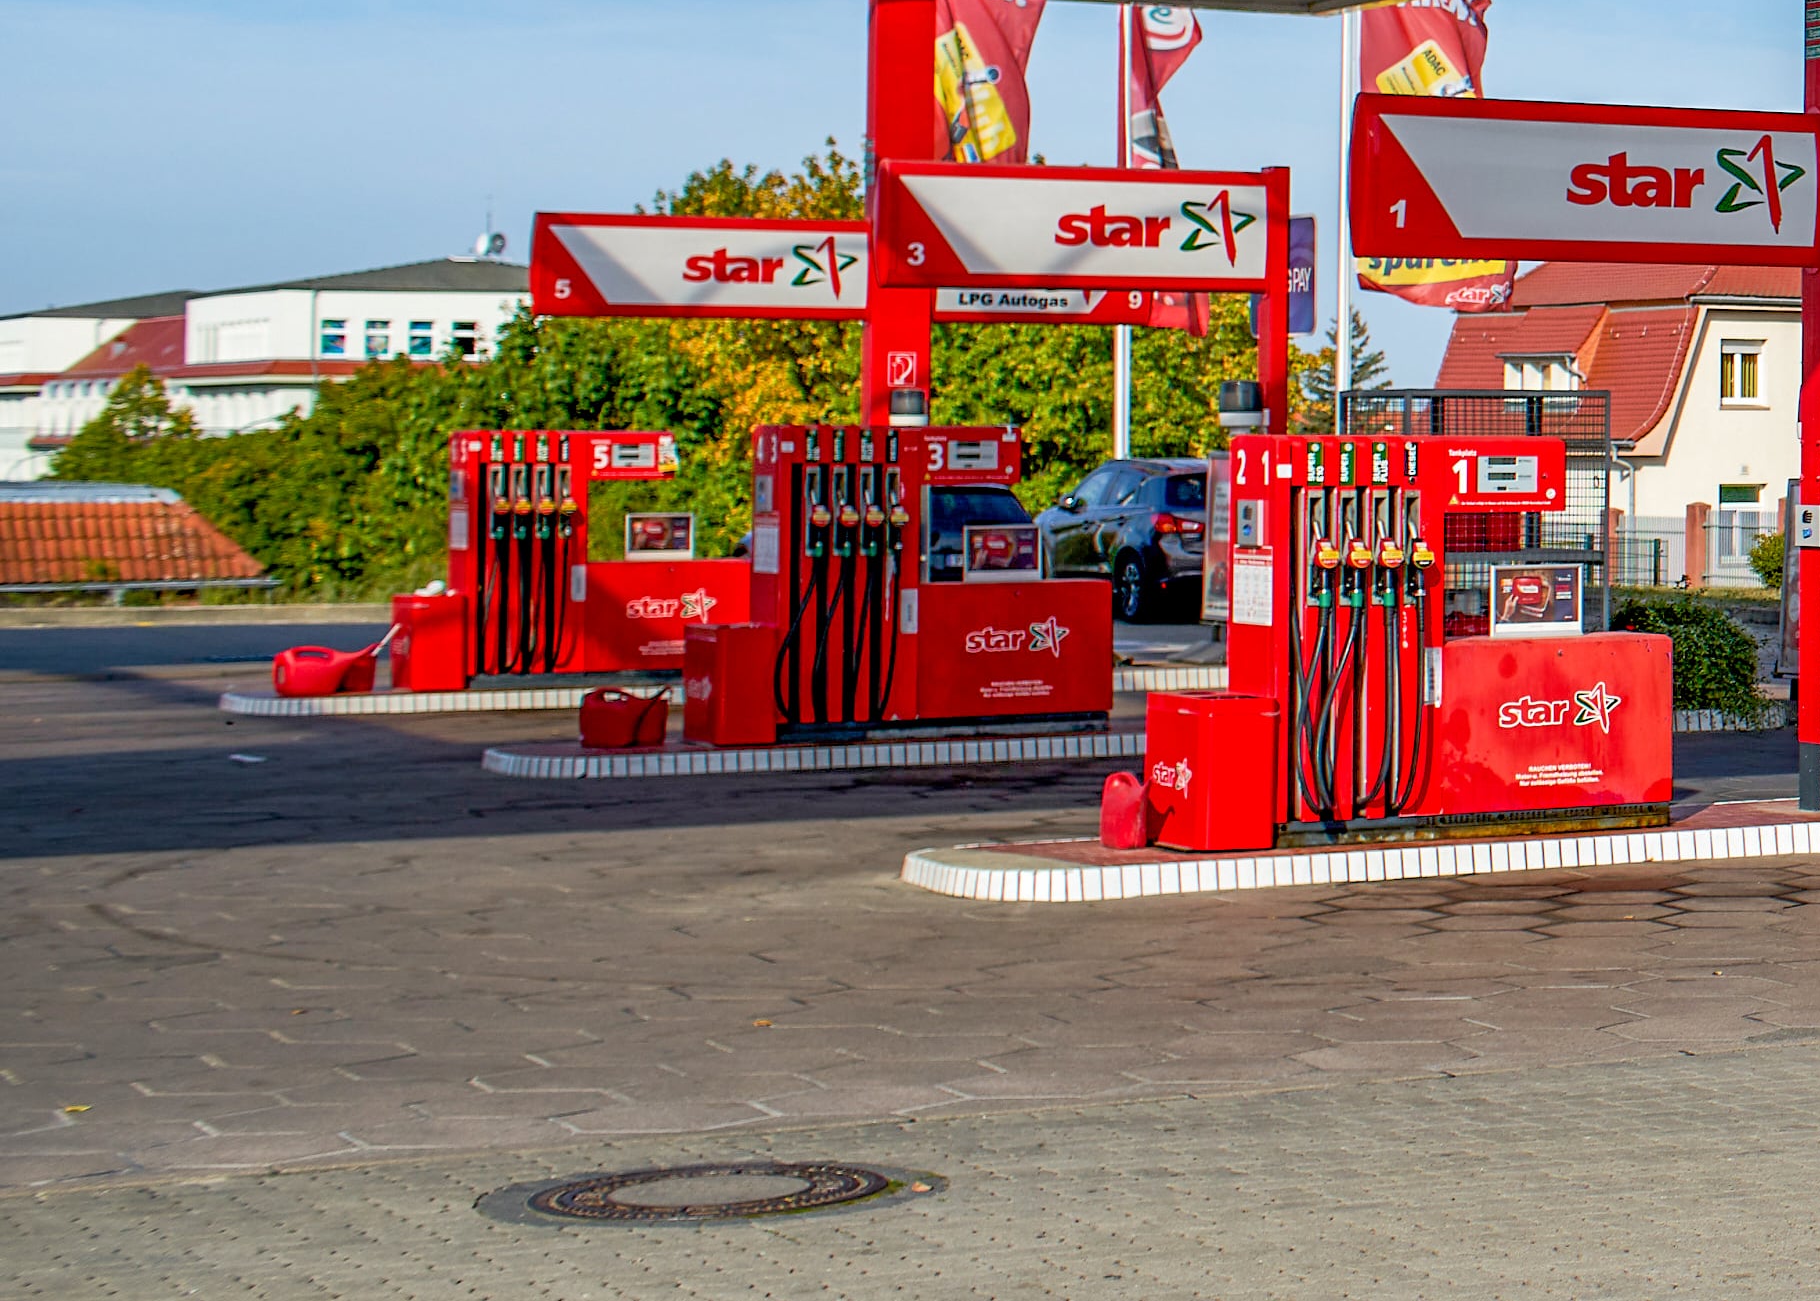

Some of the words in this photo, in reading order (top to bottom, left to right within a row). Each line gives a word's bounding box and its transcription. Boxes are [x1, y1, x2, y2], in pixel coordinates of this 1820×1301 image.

[1423, 49, 1446, 76] ADAC
[1566, 151, 1705, 209] star
[1054, 204, 1171, 249] star
[1388, 200, 1407, 229] 1
[682, 247, 784, 284] star
[906, 241, 926, 267] 3
[553, 278, 572, 300] 5
[957, 292, 994, 307] LPG
[999, 293, 1069, 309] Autogas
[1127, 290, 1143, 310] 9
[593, 444, 609, 470] 5
[927, 442, 944, 472] 3
[1236, 448, 1247, 485] 2
[1261, 450, 1270, 486] 1
[1452, 459, 1468, 494] 1
[626, 596, 680, 619] star
[965, 626, 1026, 654] star
[1499, 695, 1570, 729] star
